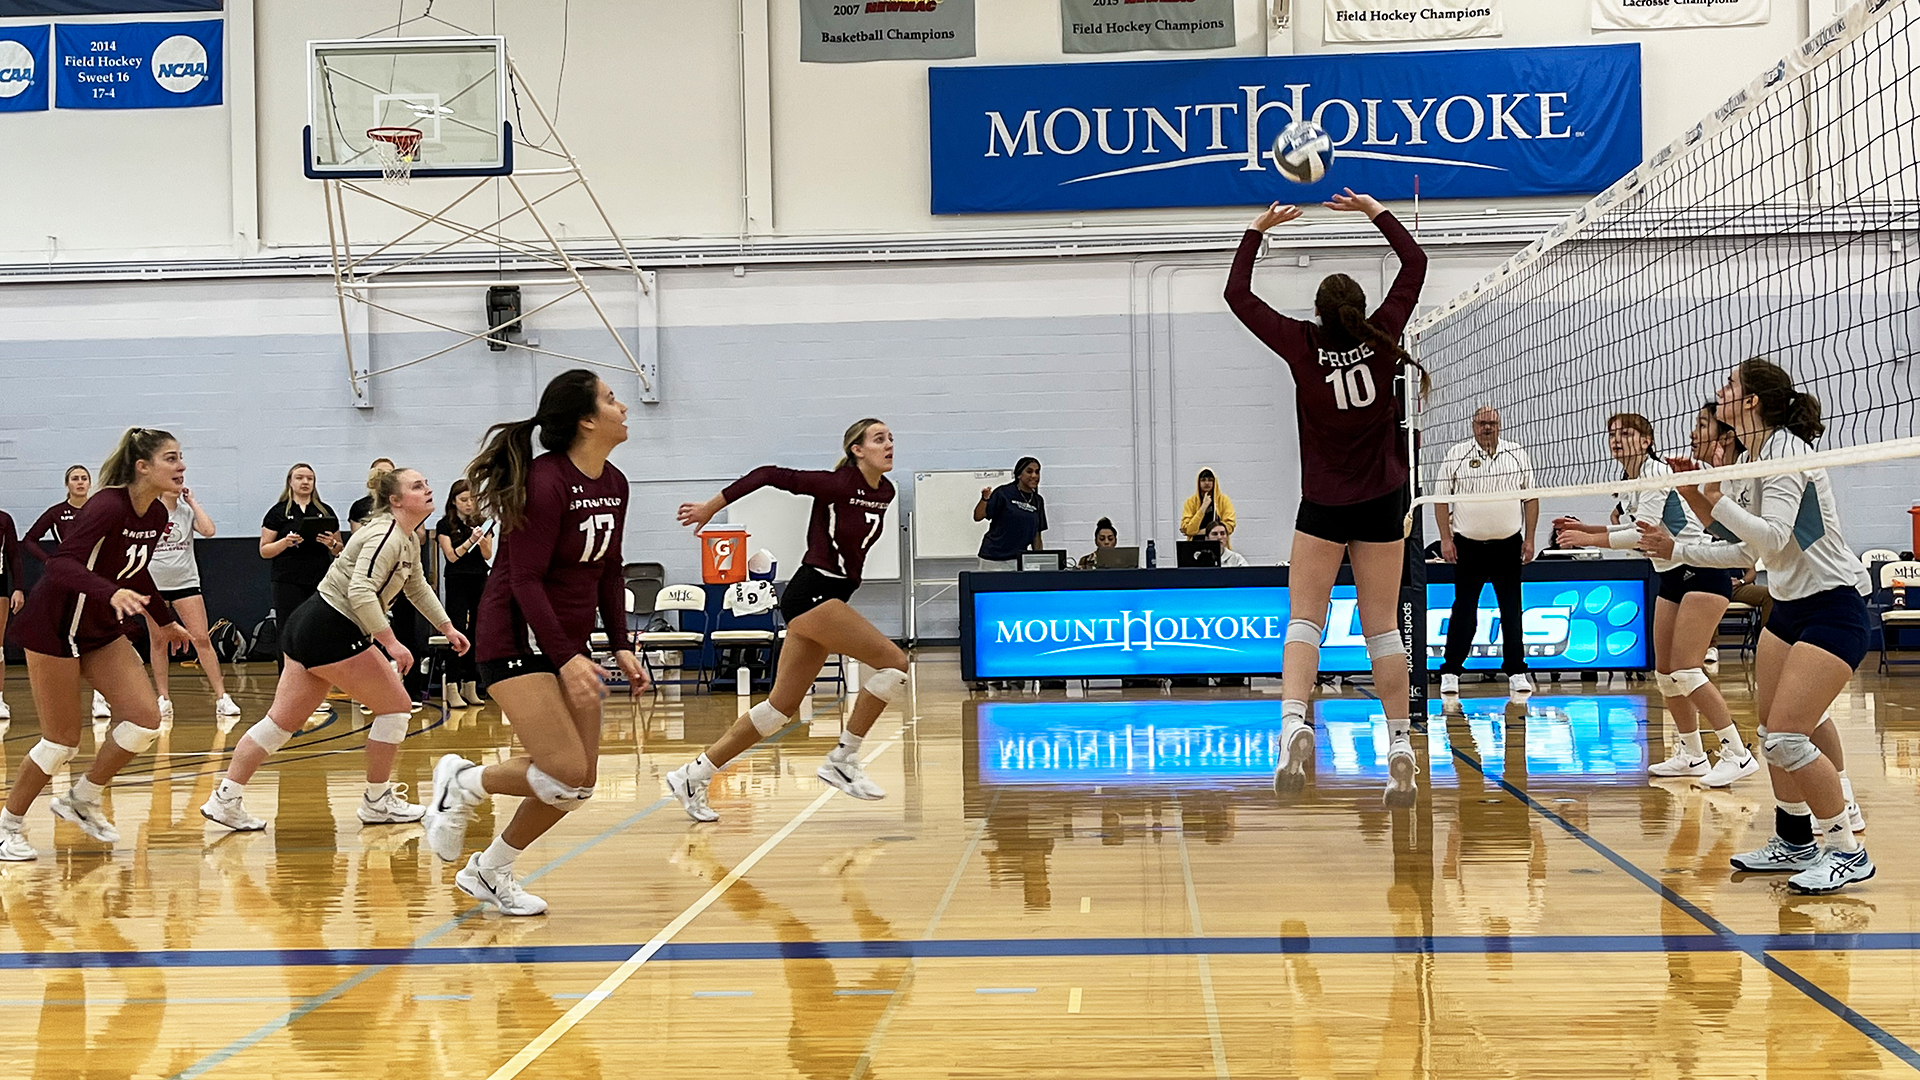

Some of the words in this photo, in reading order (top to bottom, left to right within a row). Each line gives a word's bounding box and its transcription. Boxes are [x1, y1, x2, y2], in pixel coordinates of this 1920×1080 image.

[833, 5, 860, 16] 2007
[865, 0, 938, 14] NEWMAC
[1336, 10, 1367, 21] Field
[1370, 10, 1417, 23] Hockey
[1420, 8, 1491, 22] Champions
[1072, 23, 1103, 35] Field
[1106, 21, 1151, 35] Hockey
[1155, 19, 1225, 33] Champions
[821, 29, 884, 43] Basketball
[886, 28, 955, 43] Champions
[90, 41, 117, 52] 2014
[64, 55, 95, 67] Field
[98, 55, 143, 69] Hockey
[0, 68, 32, 83] CAA
[77, 72, 114, 83] Sweet
[116, 71, 130, 82] 16
[158, 63, 206, 79] NCAA
[92, 88, 116, 99] 17-4
[984, 103, 1238, 158] MOUNT
[1238, 83, 1572, 172] HOLYOKE
[1317, 341, 1375, 367] PRIDE
[1325, 363, 1377, 410] 10
[579, 513, 615, 562] 17
[861, 512, 880, 549] 7
[715, 539, 731, 556] G
[116, 544, 148, 580] 11
[1871, 553, 1890, 561] MHC
[668, 590, 693, 602] MHC
[1402, 602, 1413, 634] sports
[995, 618, 1120, 643] MOUNT
[1120, 610, 1281, 651] HOLYOKE
